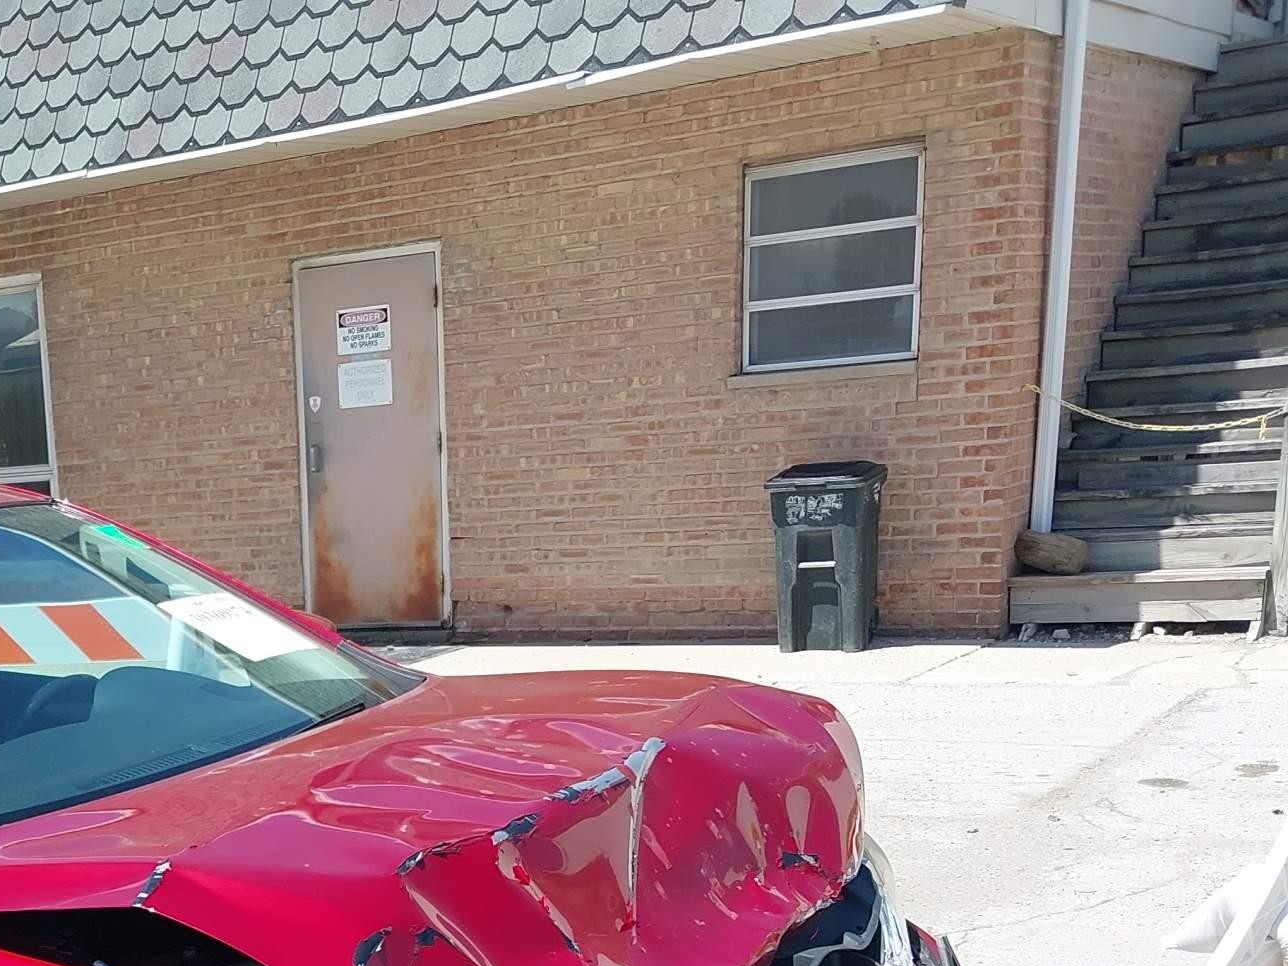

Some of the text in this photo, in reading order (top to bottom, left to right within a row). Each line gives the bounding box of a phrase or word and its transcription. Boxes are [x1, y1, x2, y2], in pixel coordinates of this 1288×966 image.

[345, 312, 381, 325] DANGER
[357, 325, 379, 334] SMOKING
[351, 333, 365, 342] OPEN
[365, 331, 385, 340] FLAMES
[359, 340, 378, 349] SPARKS
